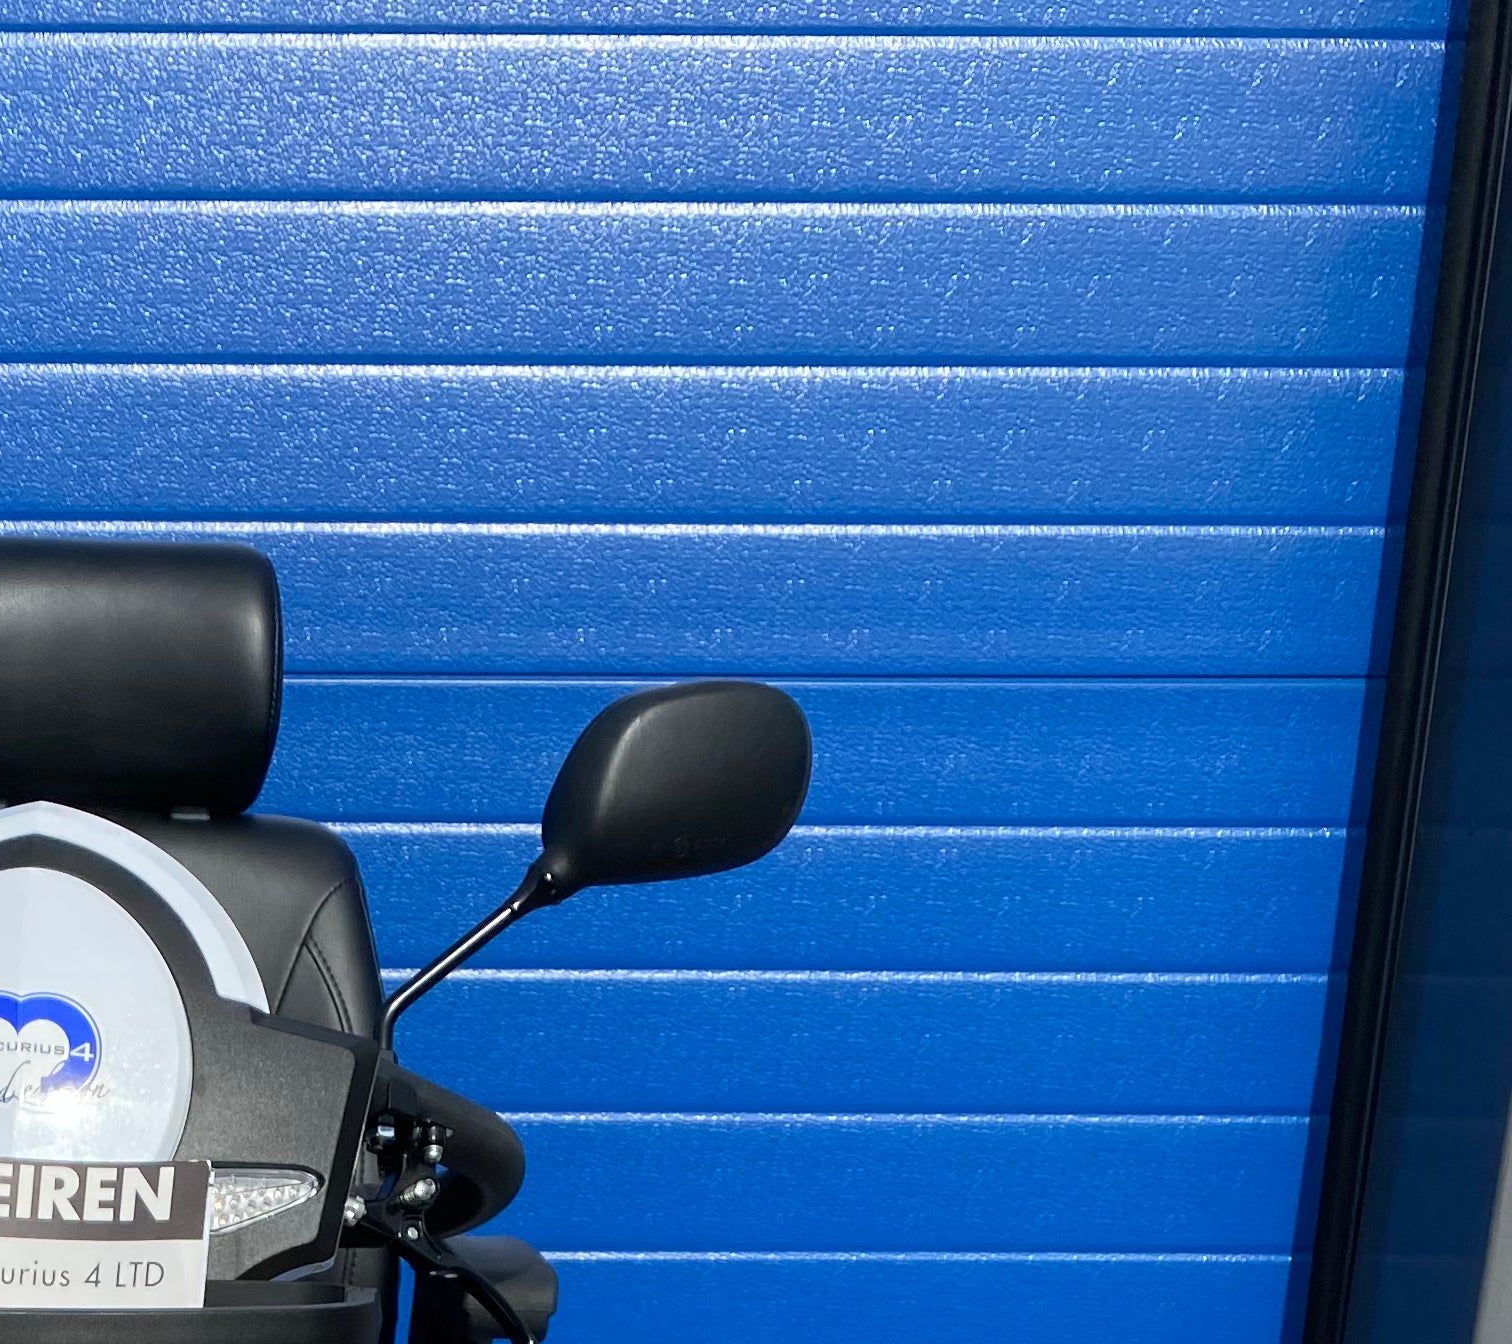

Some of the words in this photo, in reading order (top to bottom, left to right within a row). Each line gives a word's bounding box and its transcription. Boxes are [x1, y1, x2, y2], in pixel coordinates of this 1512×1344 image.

[69, 1043, 96, 1062] 4
[85, 1261, 102, 1287] 4
[117, 1261, 165, 1288] LTD
